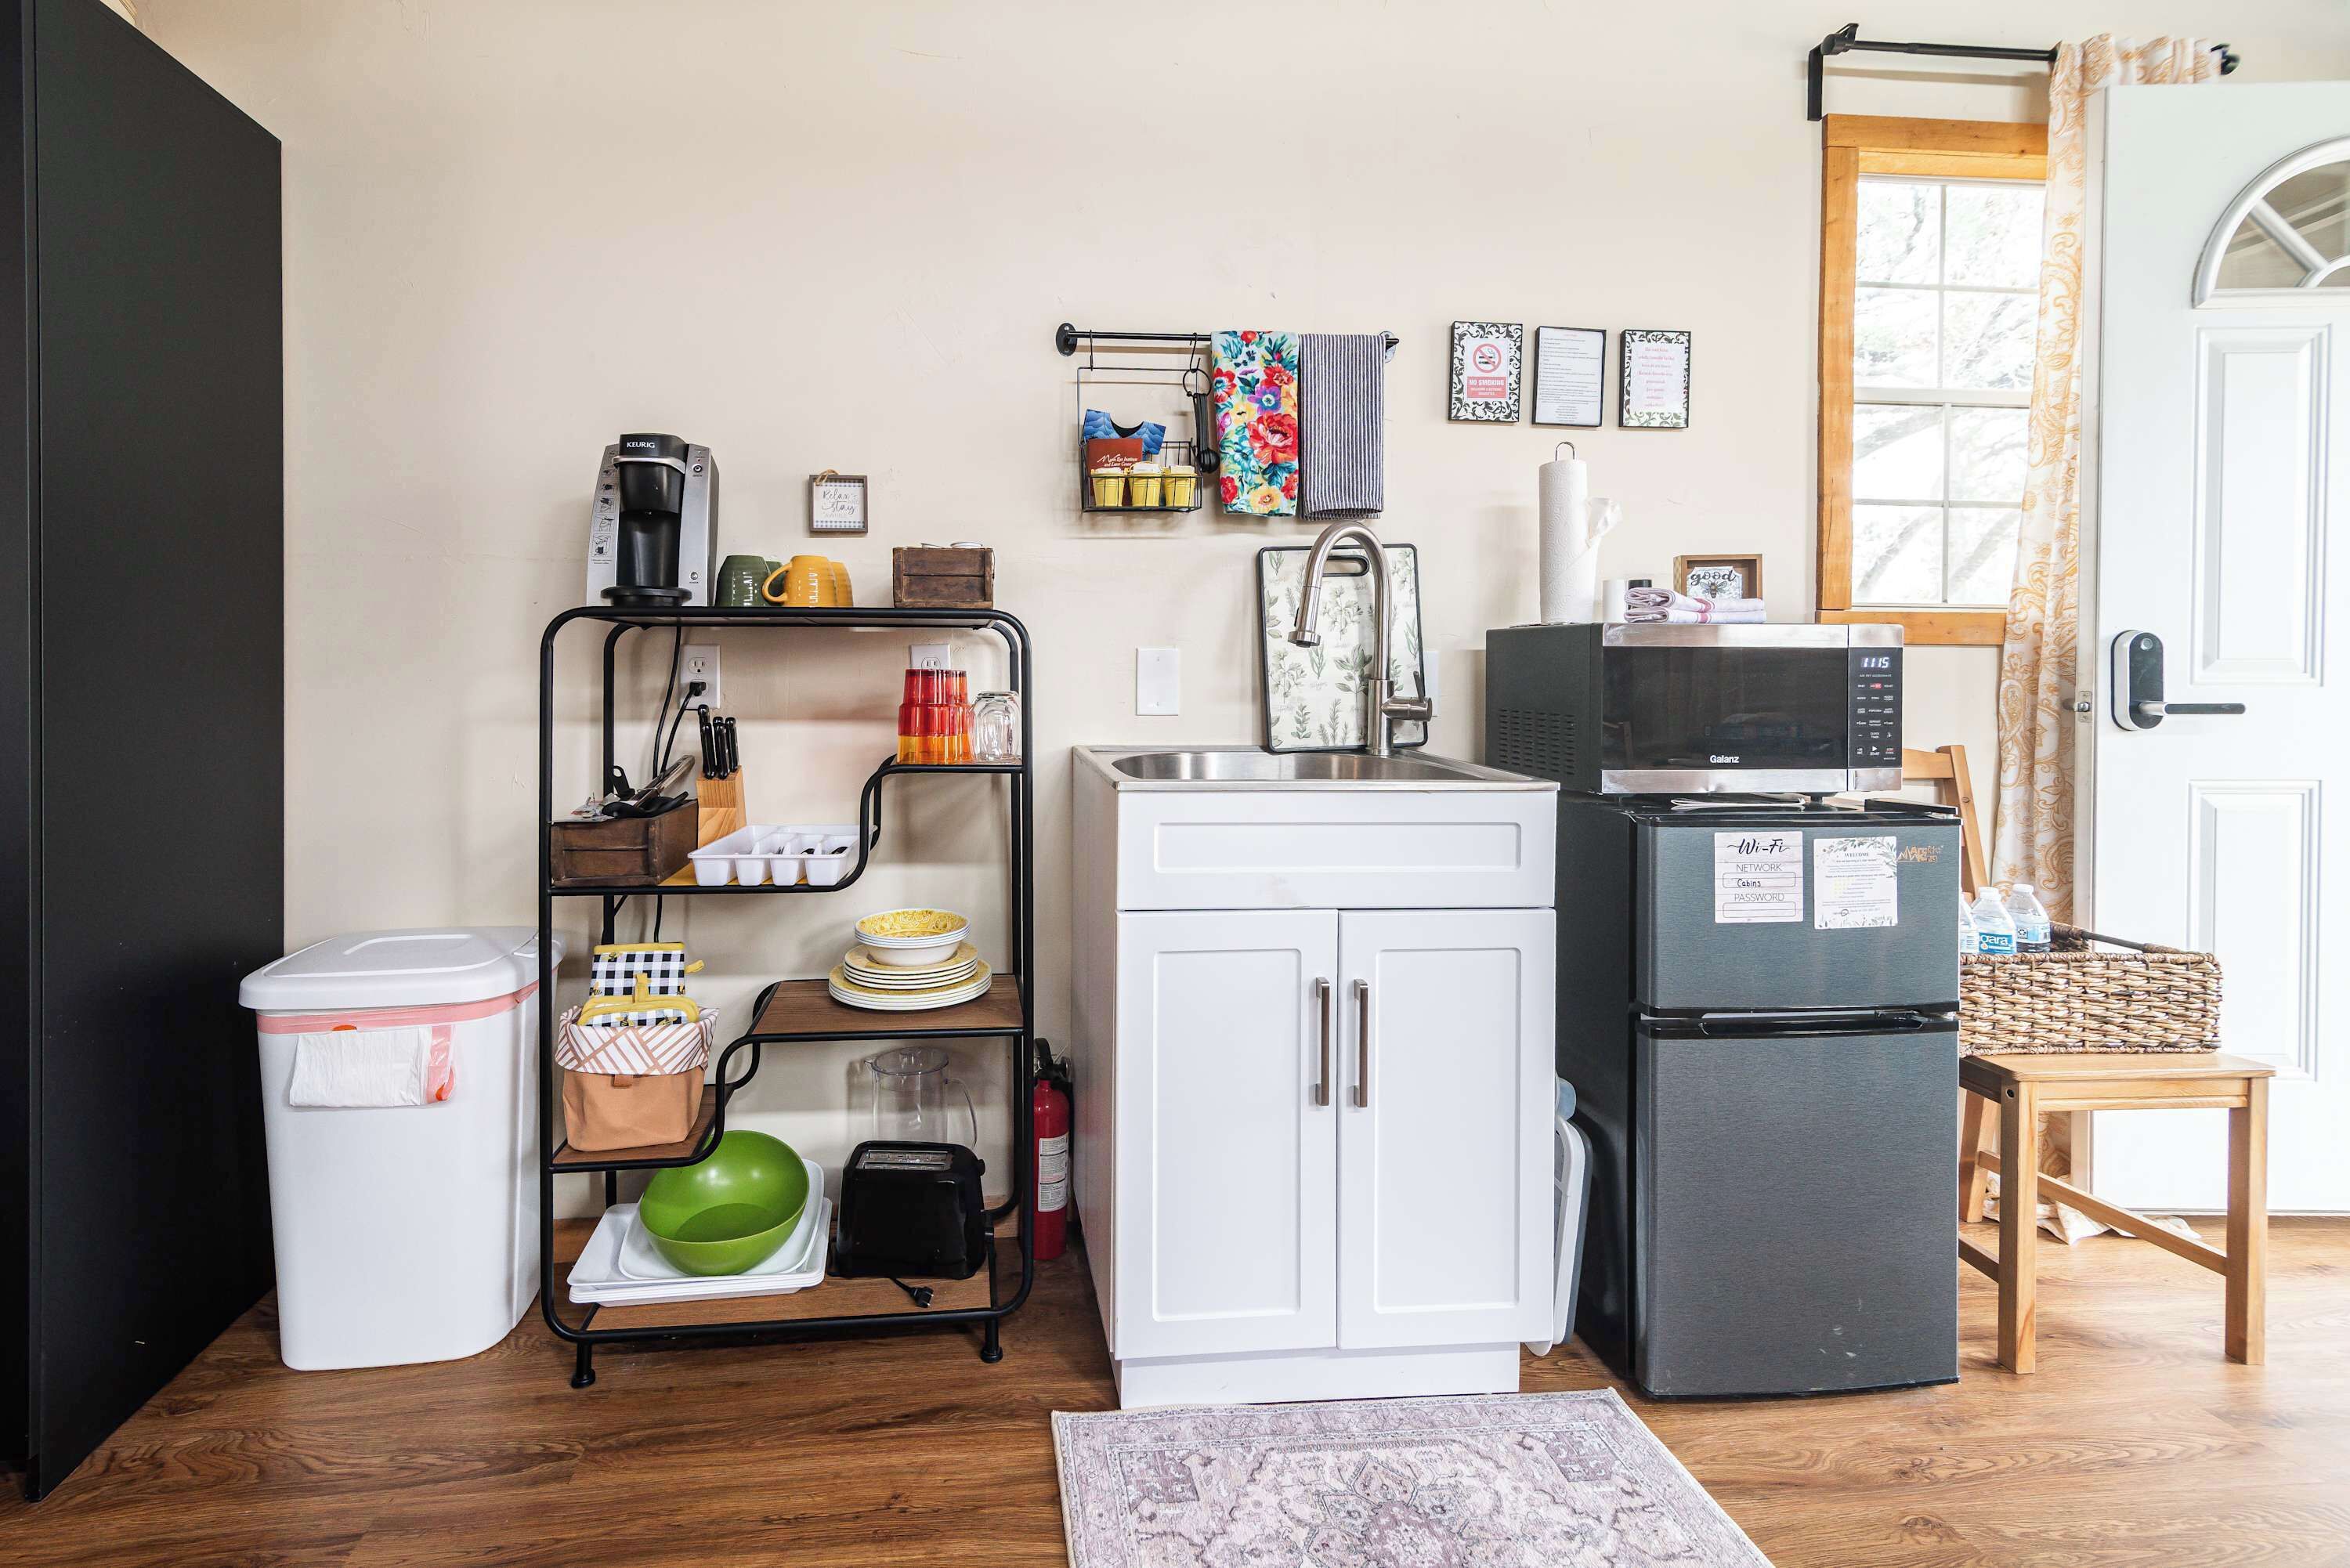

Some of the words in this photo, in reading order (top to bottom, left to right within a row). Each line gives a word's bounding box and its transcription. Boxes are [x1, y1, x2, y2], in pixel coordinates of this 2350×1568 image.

[1690, 570, 1737, 586] good
[1709, 754, 1740, 763] Galanz
[1726, 838, 1791, 854] Wi-Fi
[1736, 863, 1782, 872] NETWORK
[1734, 893, 1784, 901] PASSWORD
